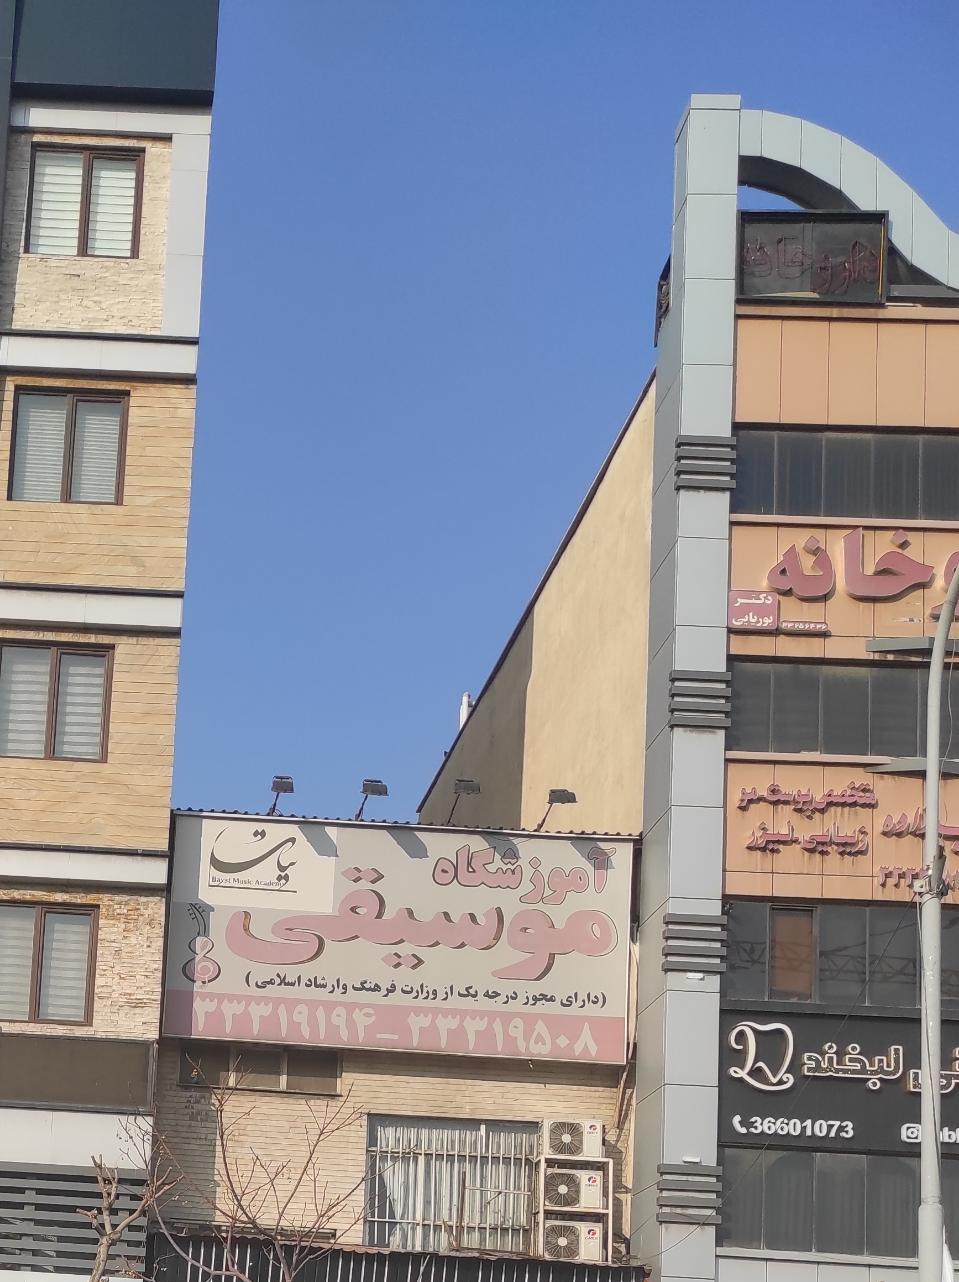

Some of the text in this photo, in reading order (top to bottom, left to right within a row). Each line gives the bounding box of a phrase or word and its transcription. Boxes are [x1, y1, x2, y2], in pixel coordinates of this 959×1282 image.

[733, 593, 773, 606] دکتر
[432, 844, 616, 905] آموزشگاه
[225, 867, 618, 981] موسیقی
[351, 979, 397, 998] فرهنگ
[401, 982, 437, 999] وزارت
[442, 984, 454, 1001] از
[458, 985, 479, 1002] یک
[483, 989, 518, 1005] درجه
[523, 991, 556, 1006] مجوز
[801, 1042, 903, 1090] لبخند
[749, 1116, 854, 1138] 36601073
